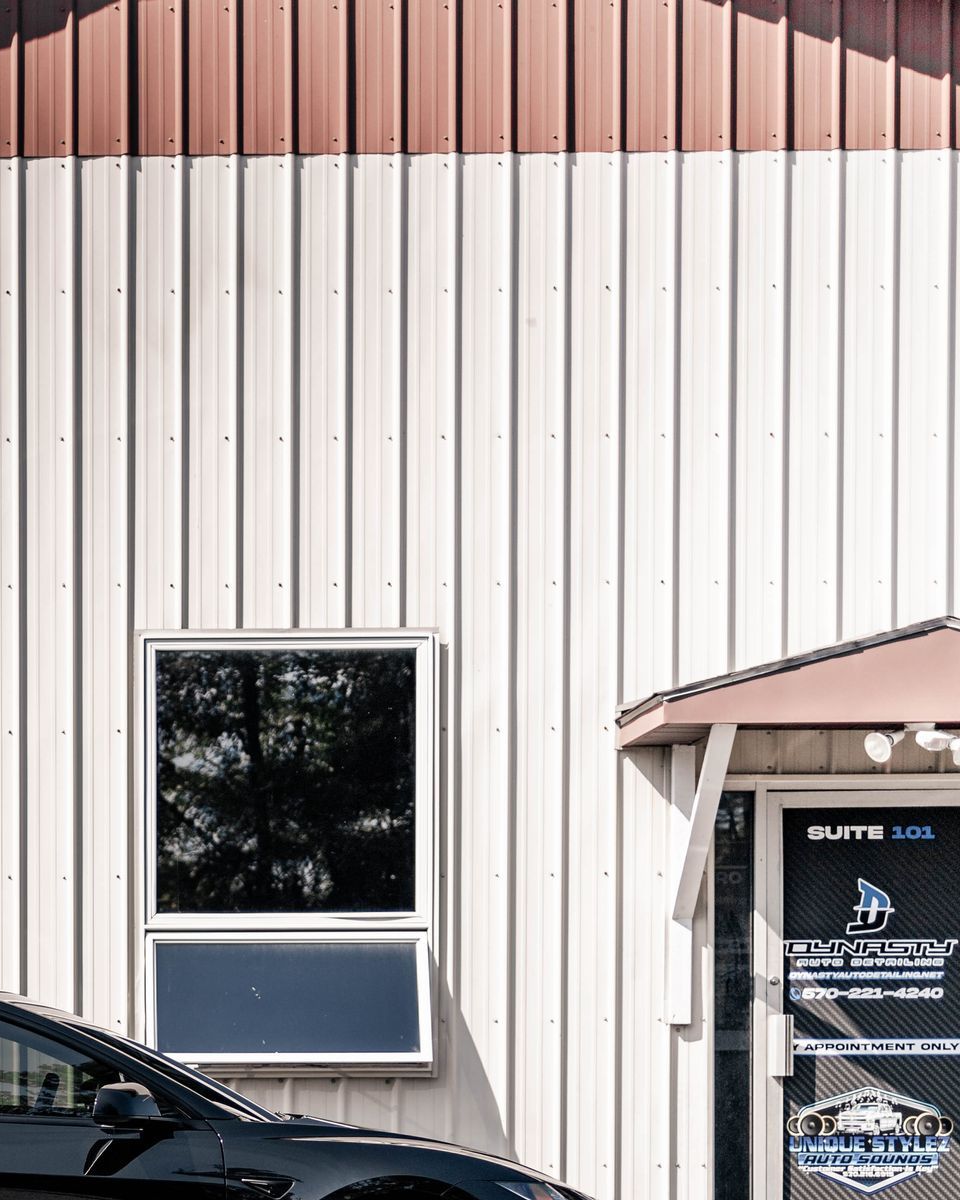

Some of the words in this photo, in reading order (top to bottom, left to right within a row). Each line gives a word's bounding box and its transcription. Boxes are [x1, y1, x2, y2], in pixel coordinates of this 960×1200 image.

[807, 825, 884, 840] SUITE
[891, 825, 935, 840] 101
[783, 939, 958, 956] DYNASTY
[796, 958, 844, 967] AUTO
[850, 958, 944, 967] DETAILING
[801, 987, 944, 999] 570-221-4240
[804, 1043, 916, 1051] APPOINTMENT
[920, 1043, 959, 1051] ONLY
[789, 1136, 866, 1152] UNIQUE
[871, 1136, 950, 1152] STYLEZ
[803, 1154, 853, 1164] AUTO
[857, 1154, 934, 1164] SOUNDS
